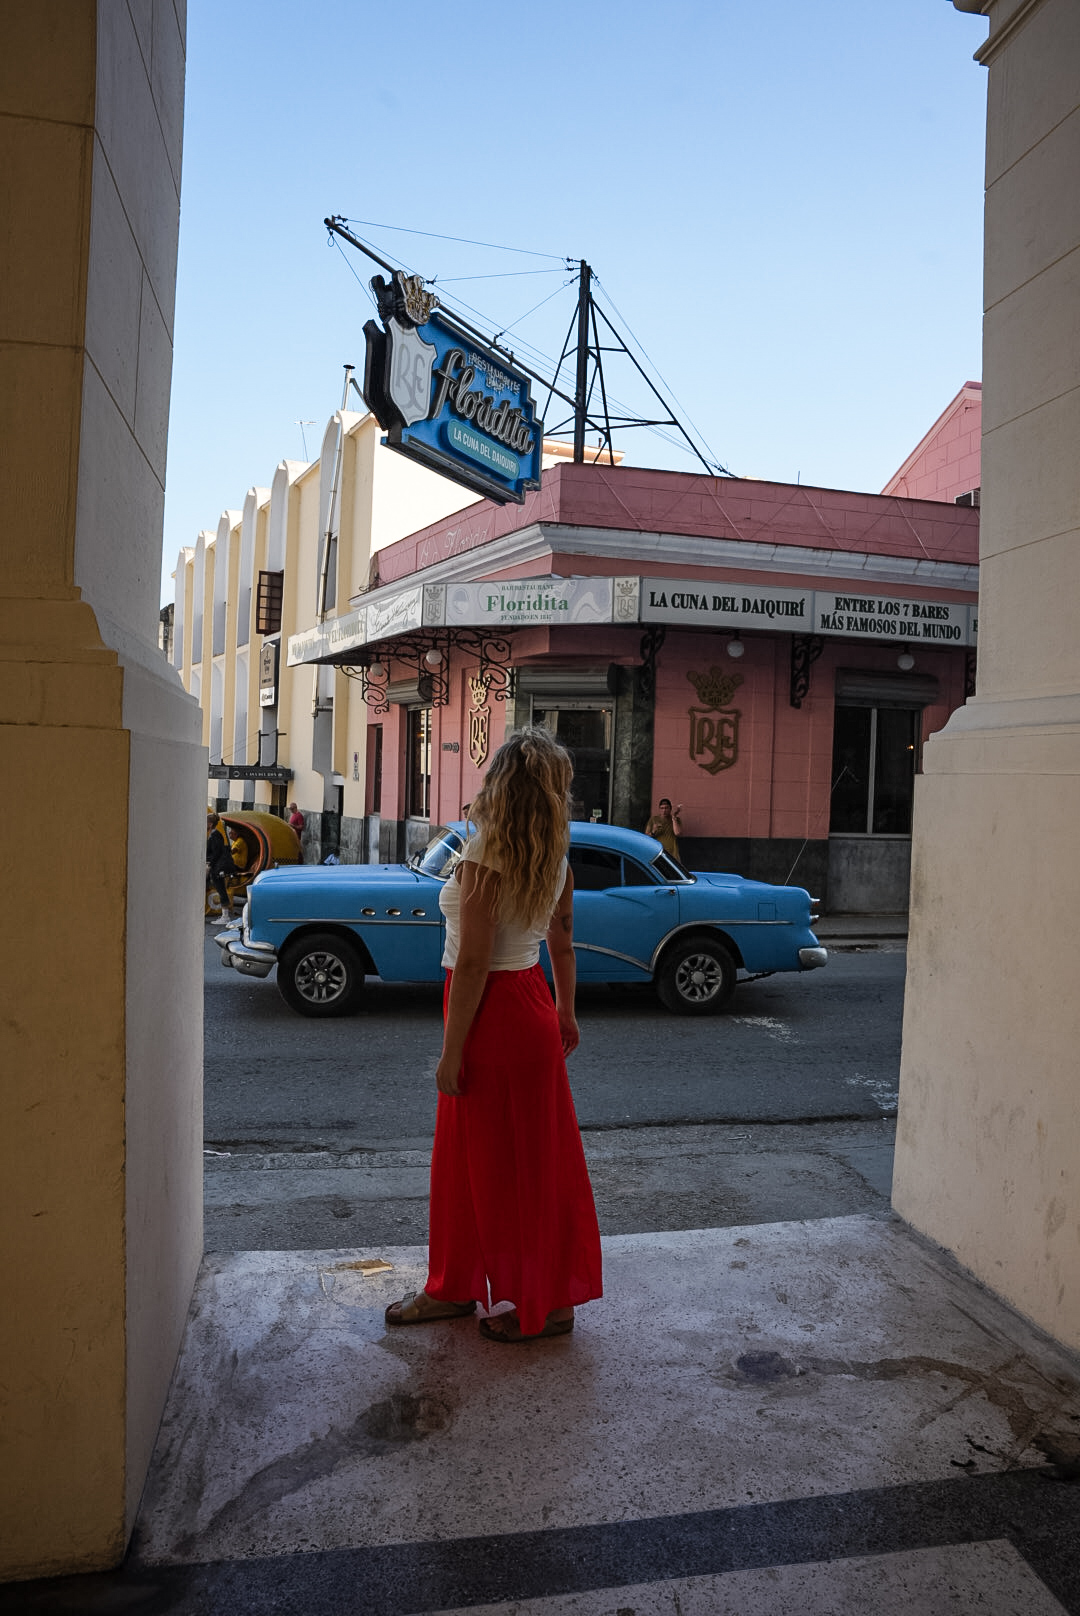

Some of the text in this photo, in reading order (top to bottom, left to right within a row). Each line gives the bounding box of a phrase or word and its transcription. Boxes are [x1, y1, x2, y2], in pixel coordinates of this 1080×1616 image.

[453, 427, 462, 441] LA
[462, 433, 480, 453] CUNA
[480, 443, 491, 459] DEL
[486, 593, 569, 612] Floridita
[649, 591, 806, 619] LA CUNA DEL DAIQUIRÍ
[834, 596, 950, 620] ENTRE LOS 7 BARES
[820, 611, 844, 631] MÁS
[846, 616, 897, 635] FAMOSOS
[899, 620, 921, 637] DEL
[922, 622, 962, 641] MUNDO
